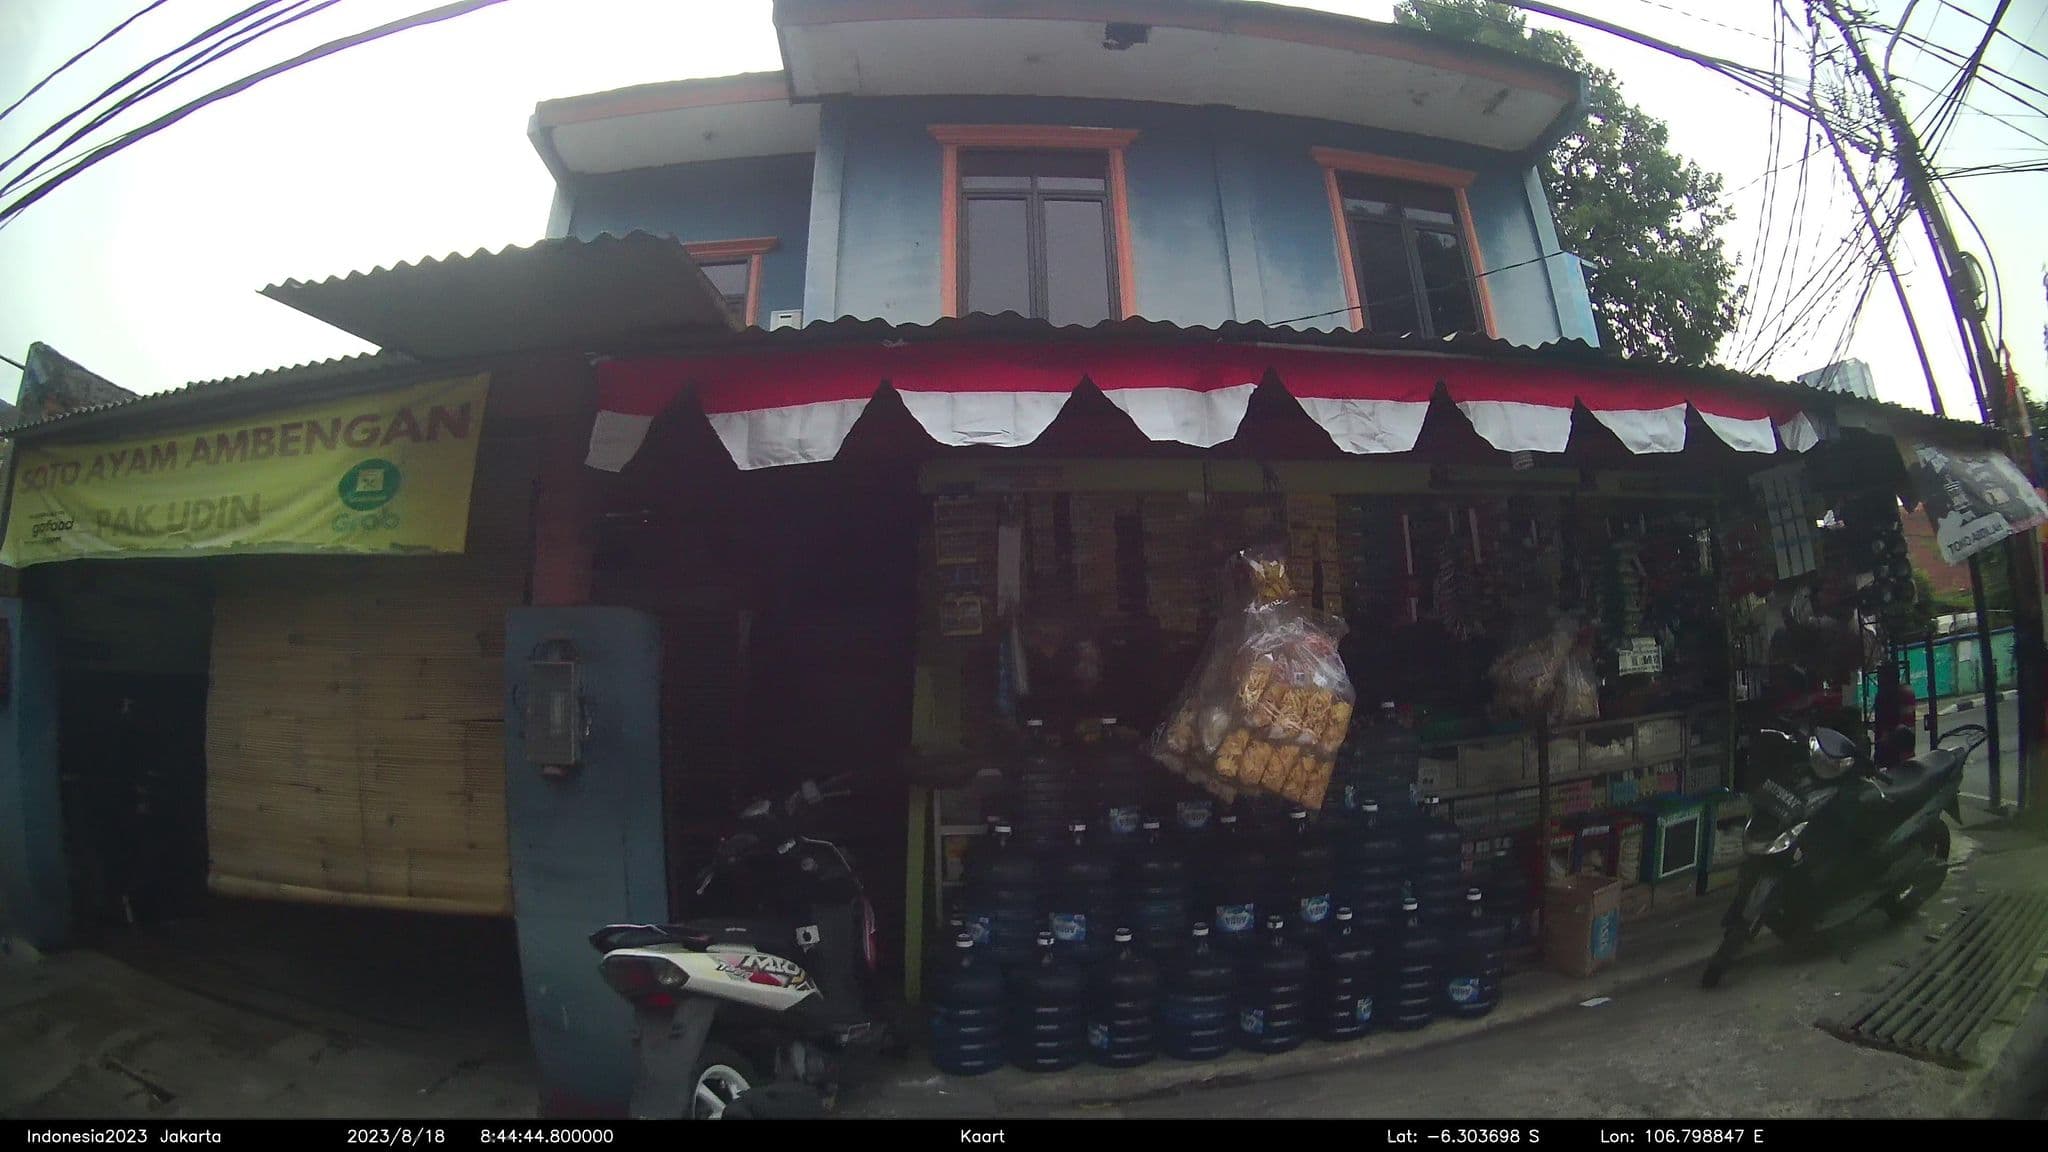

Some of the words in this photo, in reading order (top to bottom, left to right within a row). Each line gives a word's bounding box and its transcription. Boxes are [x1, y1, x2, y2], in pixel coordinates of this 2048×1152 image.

[20, 461, 80, 493] SOTO
[86, 441, 178, 482] AYAM
[185, 402, 473, 468] AMBENGAN
[97, 503, 155, 538] PAK
[166, 493, 262, 534] UDIN
